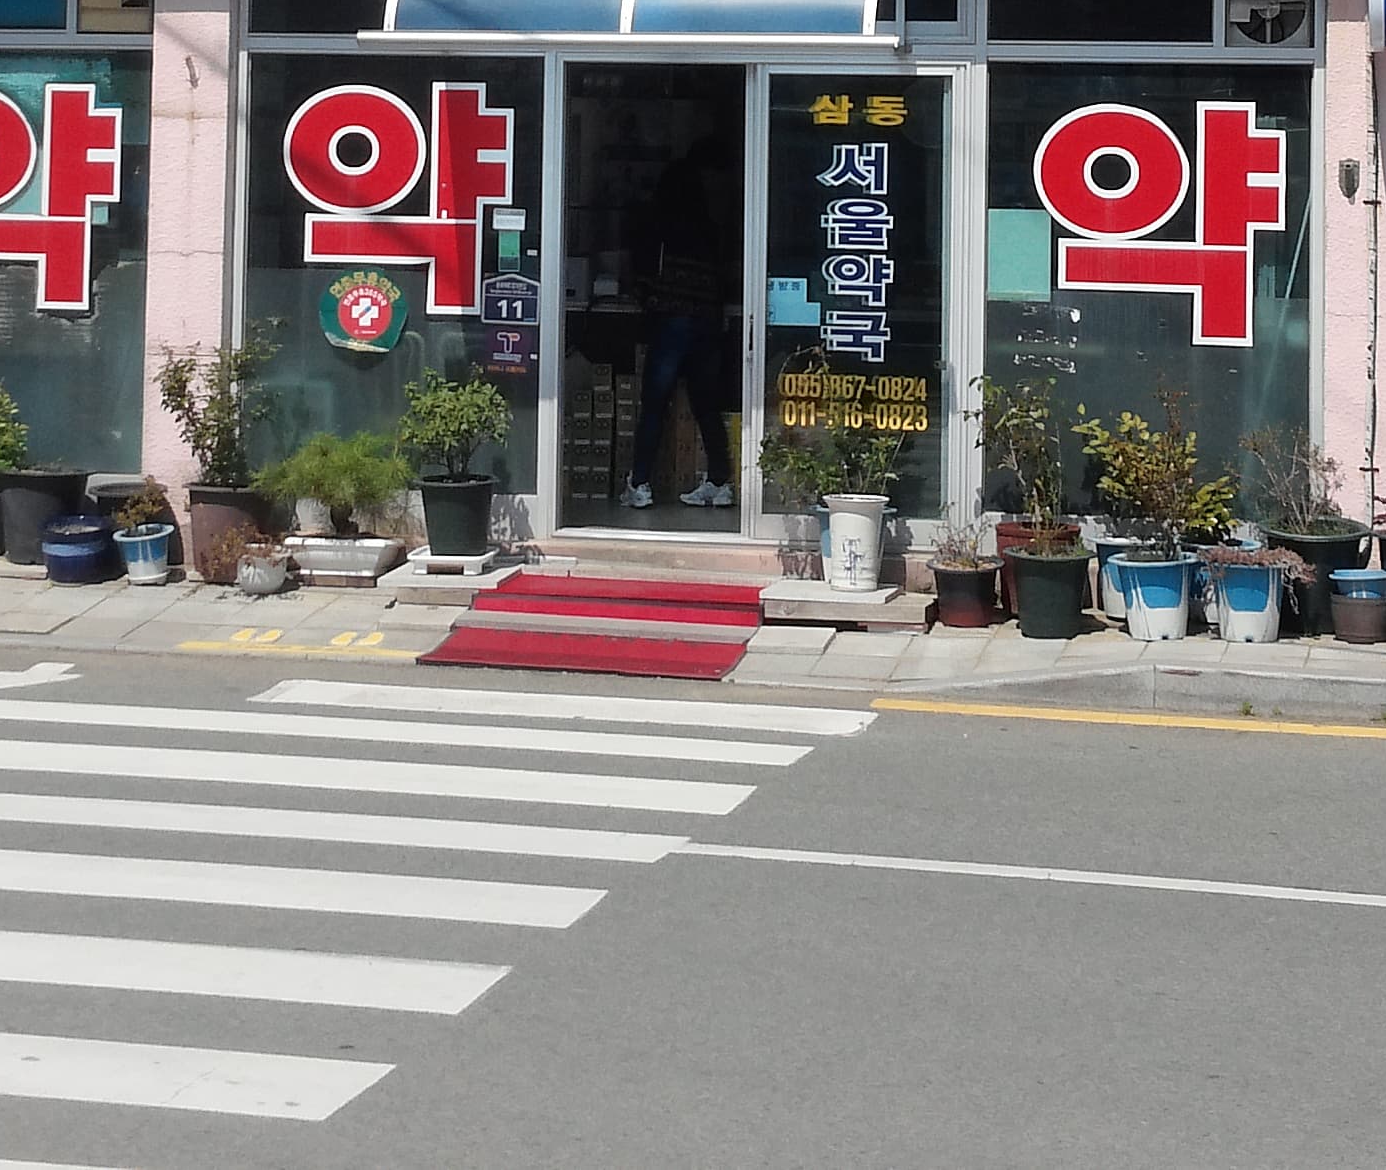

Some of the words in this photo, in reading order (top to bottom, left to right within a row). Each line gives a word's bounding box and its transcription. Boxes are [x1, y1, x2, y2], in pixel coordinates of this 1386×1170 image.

[283, 82, 515, 315] 약
[809, 95, 908, 126] 삼동
[497, 299, 523, 319] 11
[816, 142, 894, 363] 서울약국
[1033, 101, 1286, 347] 약
